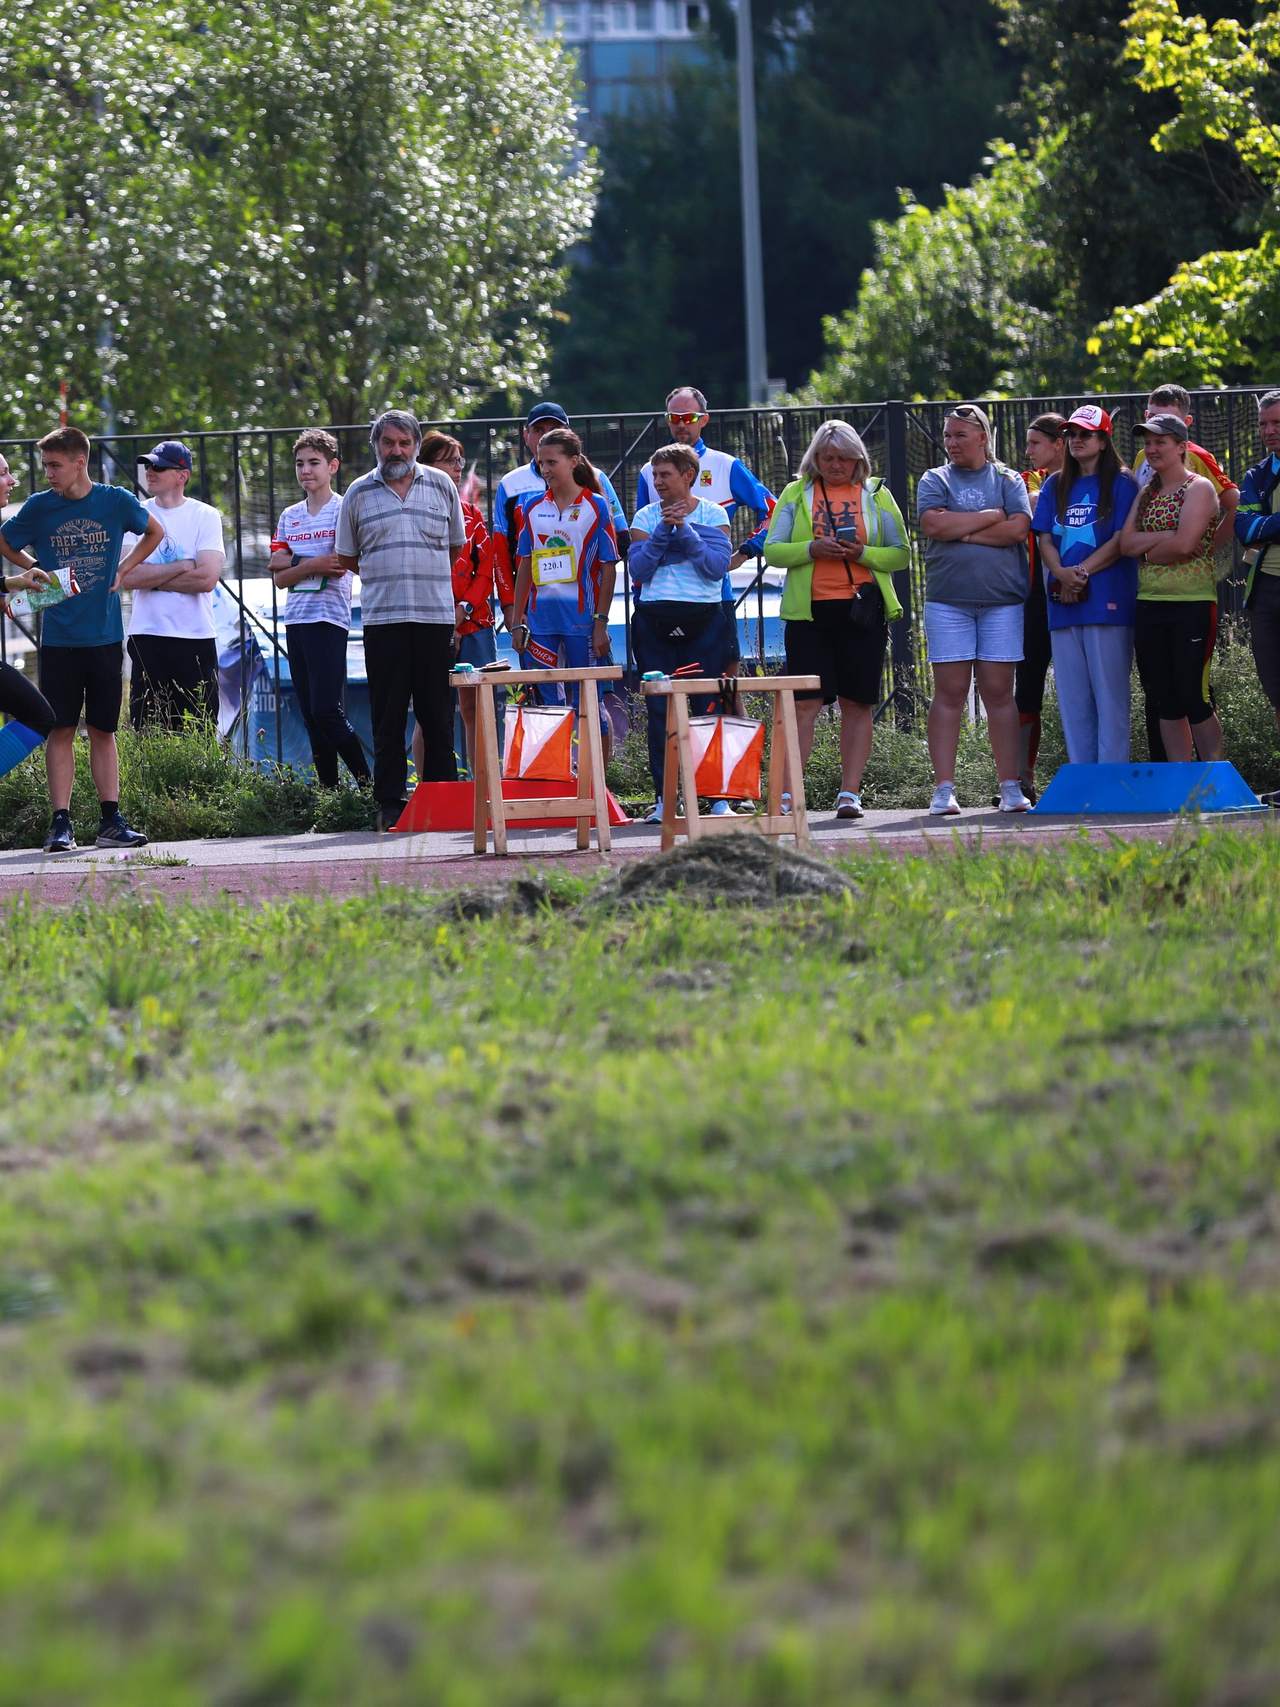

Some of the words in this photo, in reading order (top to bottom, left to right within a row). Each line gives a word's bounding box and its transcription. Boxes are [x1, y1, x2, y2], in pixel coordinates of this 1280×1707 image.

[50, 535, 77, 547] FREE
[82, 531, 110, 544] SOUL
[314, 530, 335, 539] WES
[62, 548, 69, 556] 18
[90, 545, 98, 553] 65
[543, 561, 563, 571] 220.1
